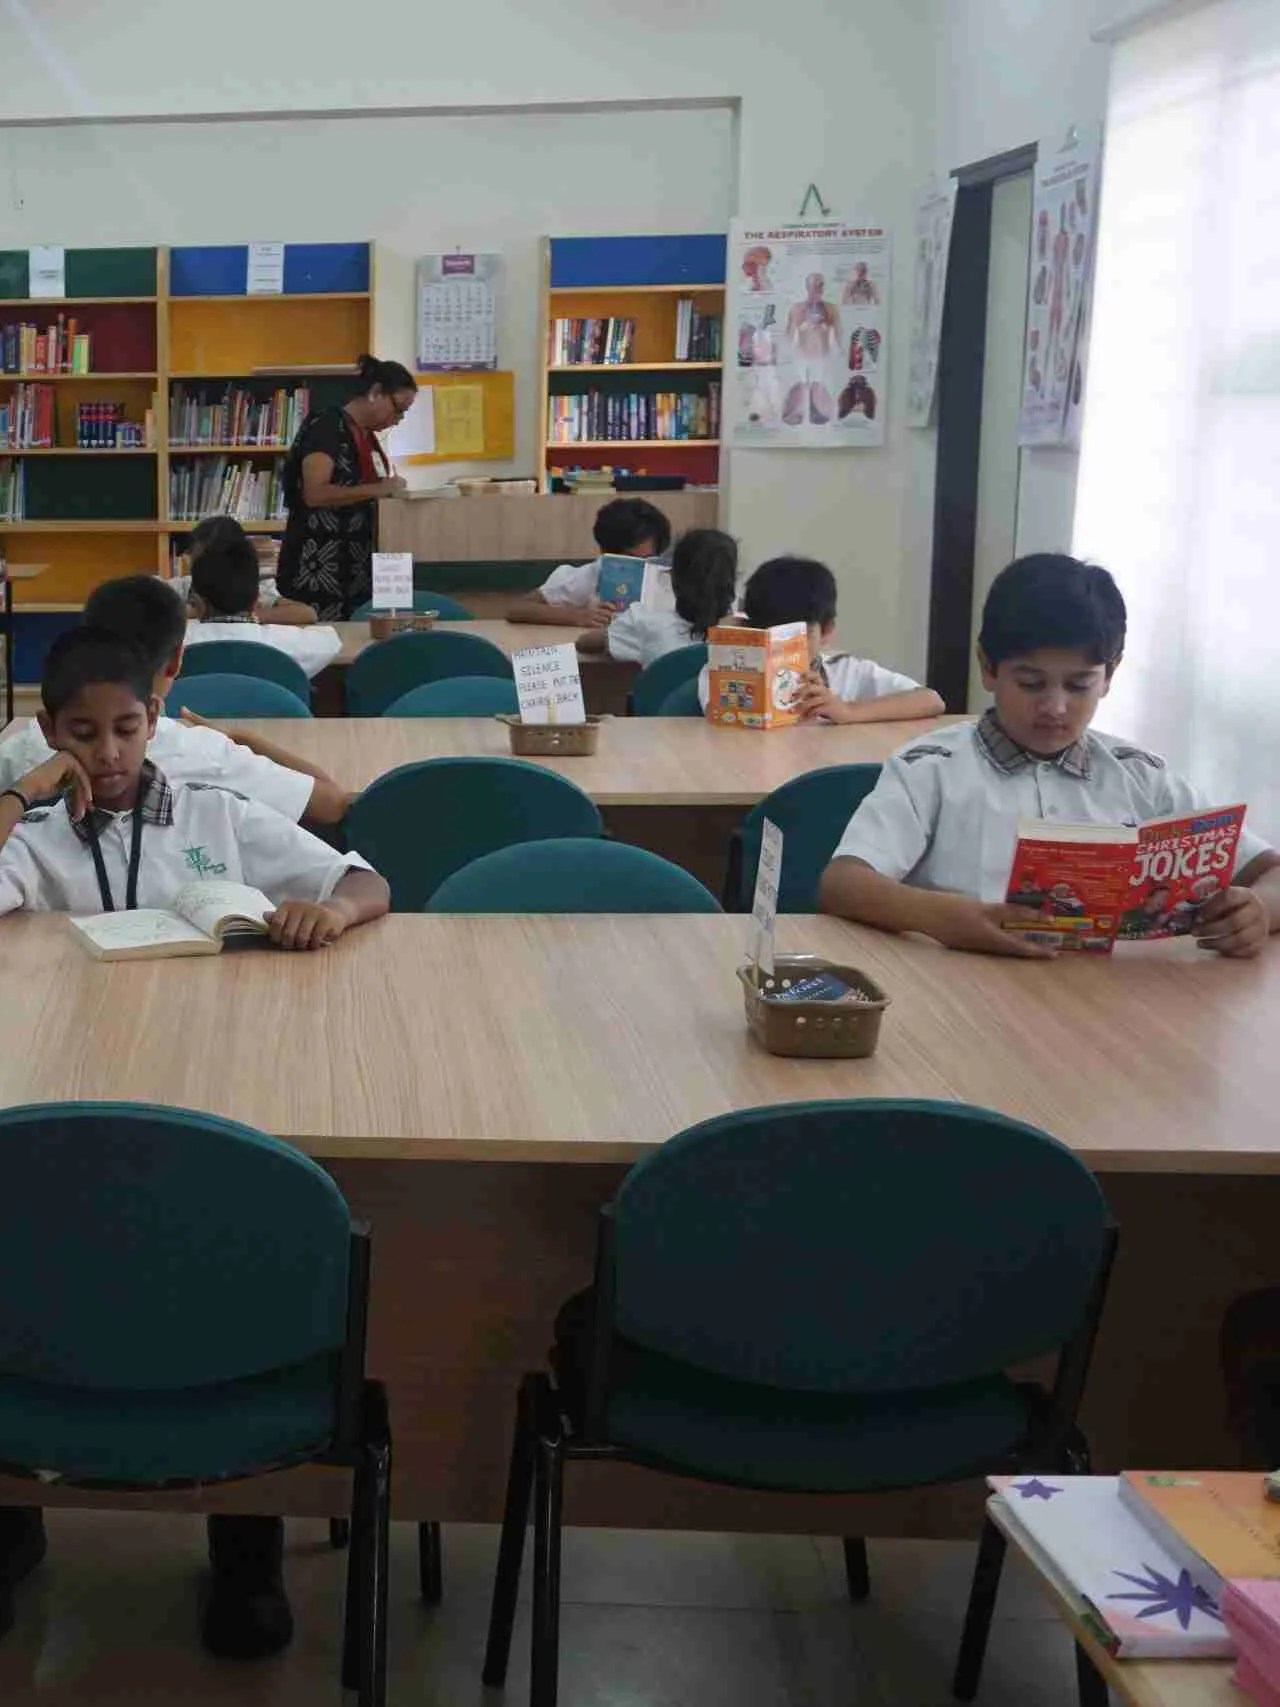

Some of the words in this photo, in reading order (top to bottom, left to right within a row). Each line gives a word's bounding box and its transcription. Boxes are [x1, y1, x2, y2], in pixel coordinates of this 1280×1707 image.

[743, 231, 765, 240] THE
[767, 229, 839, 240] RESPIRATORY
[841, 228, 883, 238] SYSTEM
[1136, 823, 1239, 855] CHRISTMAS
[1128, 837, 1234, 887] JOKES
